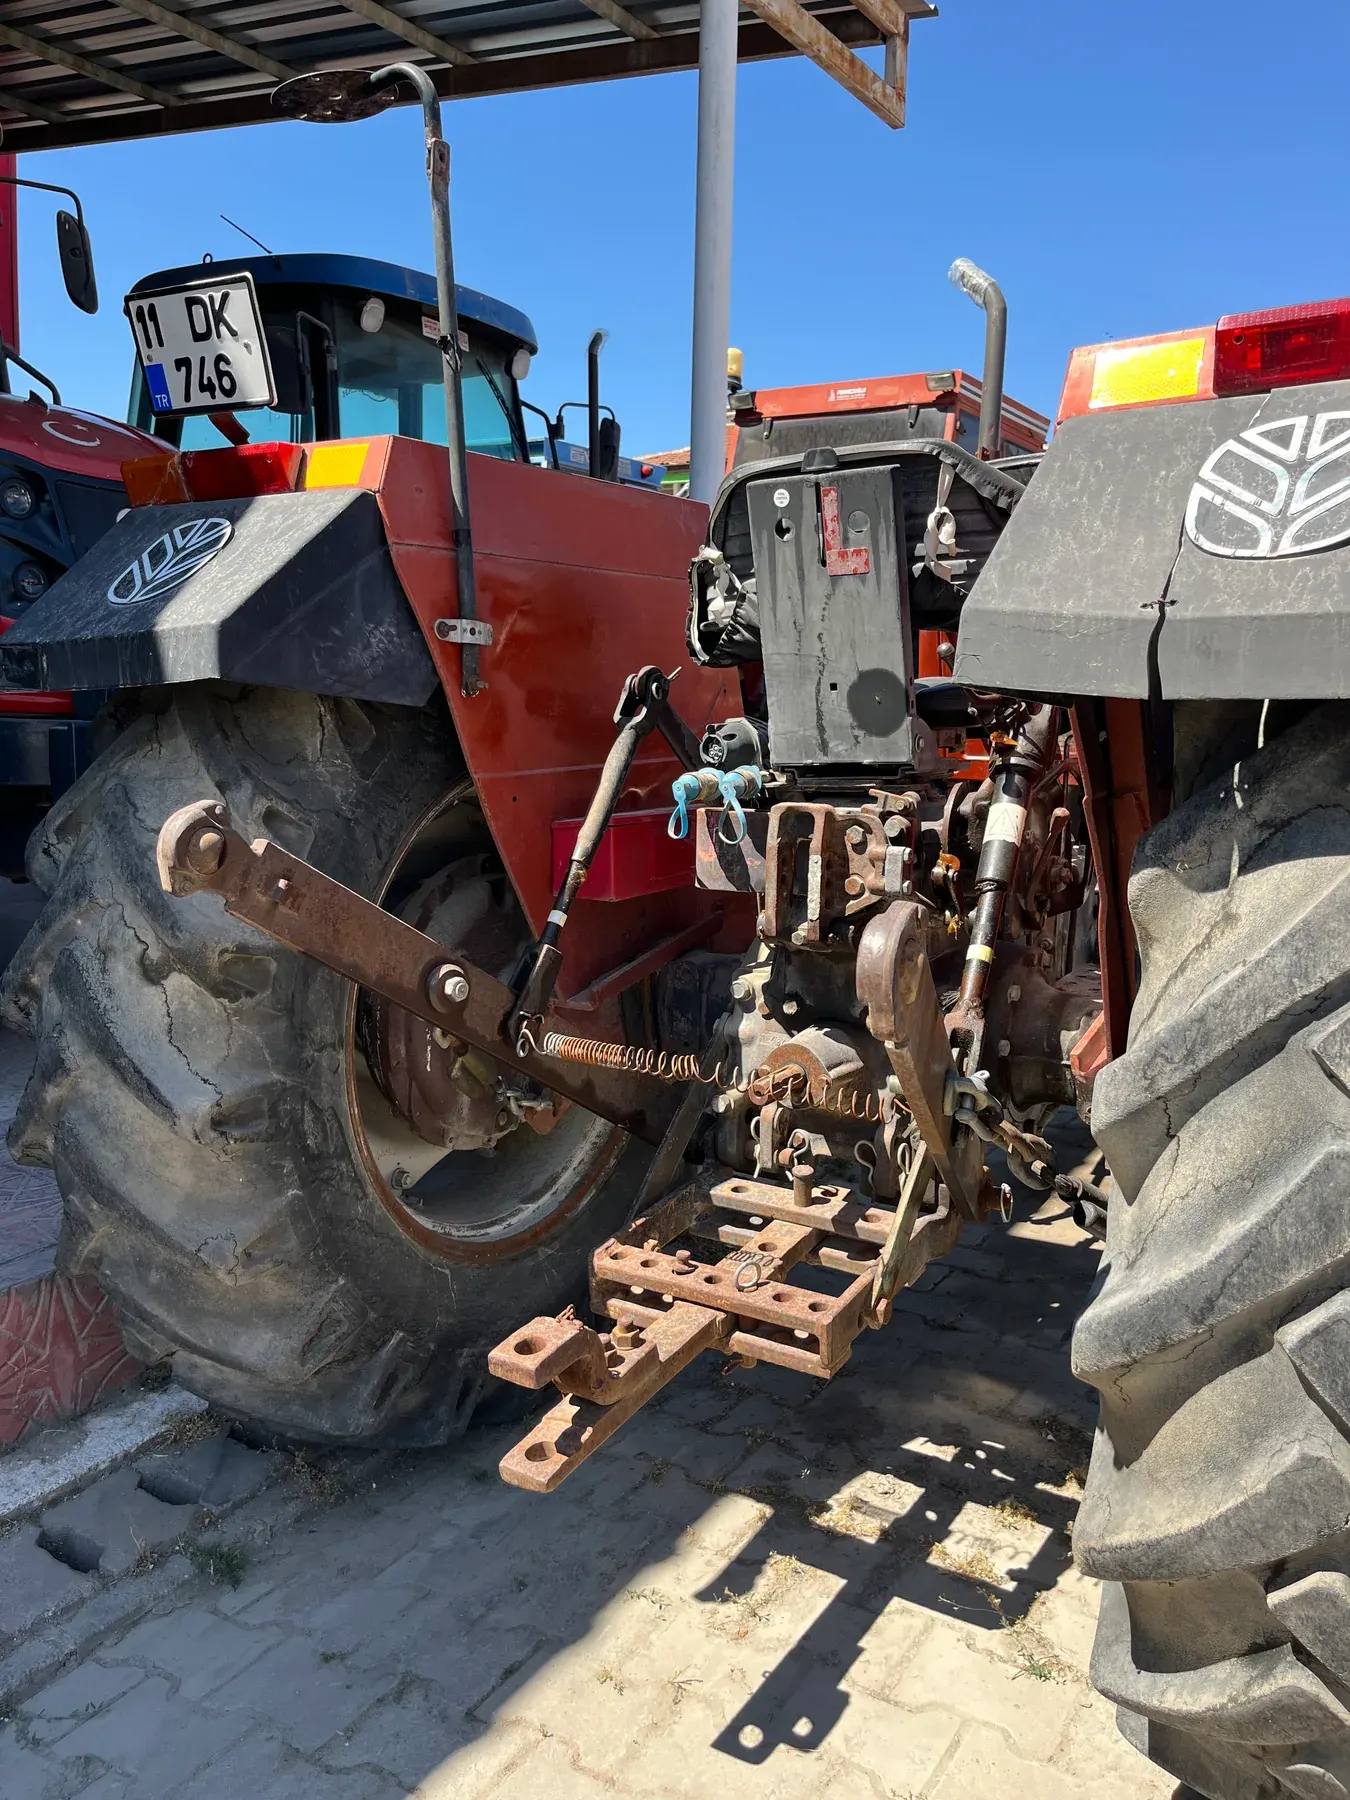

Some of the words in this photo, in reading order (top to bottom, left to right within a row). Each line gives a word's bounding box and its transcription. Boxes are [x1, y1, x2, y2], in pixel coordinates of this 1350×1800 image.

[136, 302, 164, 349] 11
[184, 290, 238, 343] DK
[155, 394, 169, 408] TR
[174, 353, 237, 403] 746
